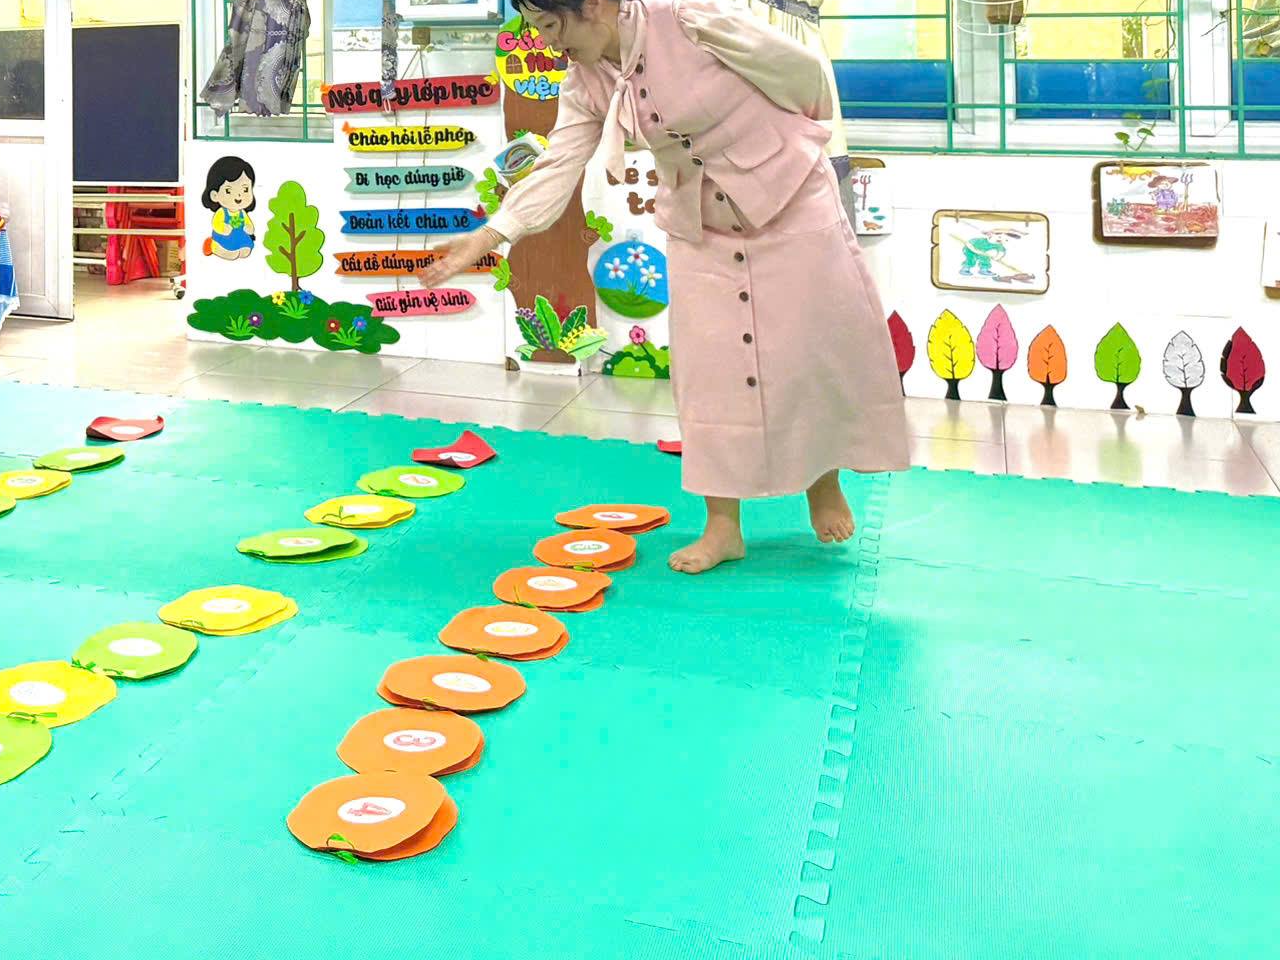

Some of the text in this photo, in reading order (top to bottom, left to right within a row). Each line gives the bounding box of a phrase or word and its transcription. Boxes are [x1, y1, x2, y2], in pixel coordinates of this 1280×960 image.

[328, 79, 493, 111] Nội qy lớp học
[349, 126, 477, 146] Chào hỏi lễ phép
[355, 166, 465, 189] Đi học đúng giờ
[350, 212, 385, 230] Đoàn
[387, 208, 410, 229] kết
[415, 212, 449, 229] chia
[342, 252, 362, 271] Cất
[363, 253, 380, 271] đồ
[381, 252, 414, 272] đúng
[375, 295, 398, 311] Giữ
[423, 292, 439, 312] vệ
[440, 291, 470, 306] sinh
